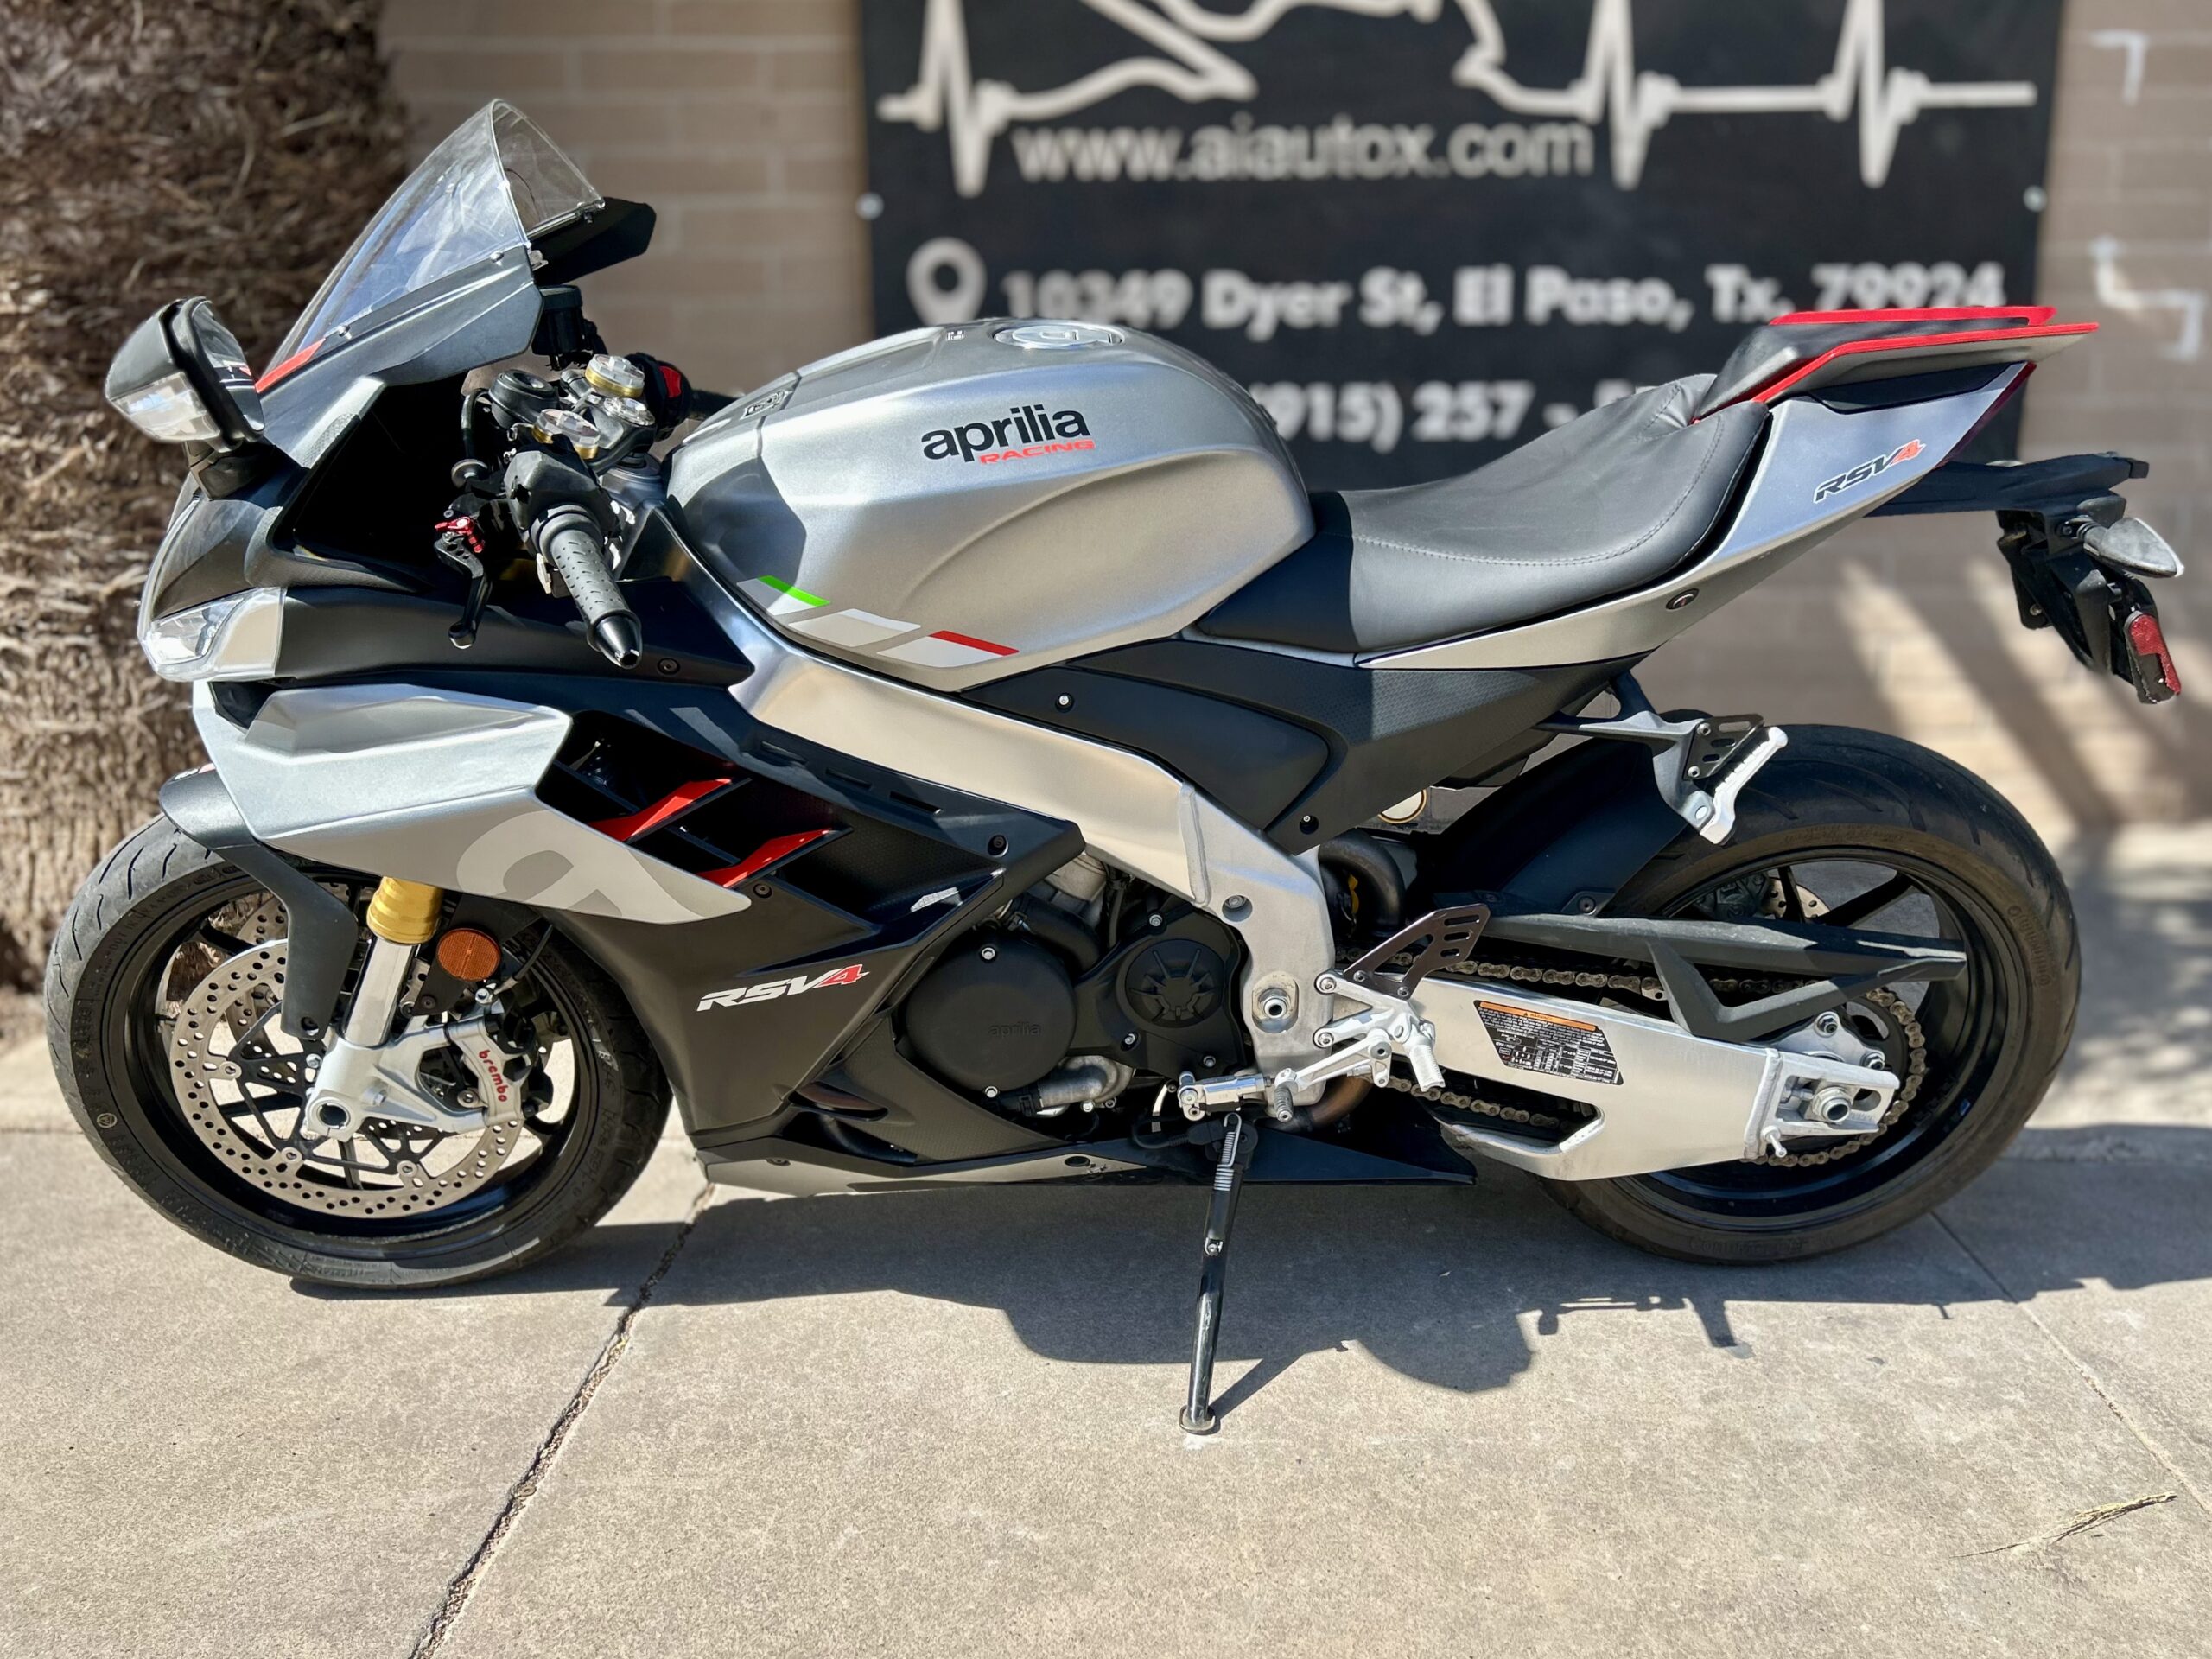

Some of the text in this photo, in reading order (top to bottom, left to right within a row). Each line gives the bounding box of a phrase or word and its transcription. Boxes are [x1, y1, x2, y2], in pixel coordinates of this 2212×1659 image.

[1011, 112, 1595, 182] www.aiautox.com
[1001, 269, 1193, 328] 10349
[1202, 268, 1353, 342] Dyer
[1359, 266, 1443, 335] St,
[1453, 264, 1515, 327] El
[1524, 264, 1694, 333] Paso,
[1812, 263, 2007, 311] 79924
[921, 404, 1092, 463] aprilia
[1411, 380, 1535, 442] 257
[978, 439, 1096, 465] RACING
[1814, 438, 1927, 504] RSV4
[696, 963, 870, 1012] RSV4
[988, 1021, 1042, 1039] aprilia
[479, 1049, 509, 1103] brembo
